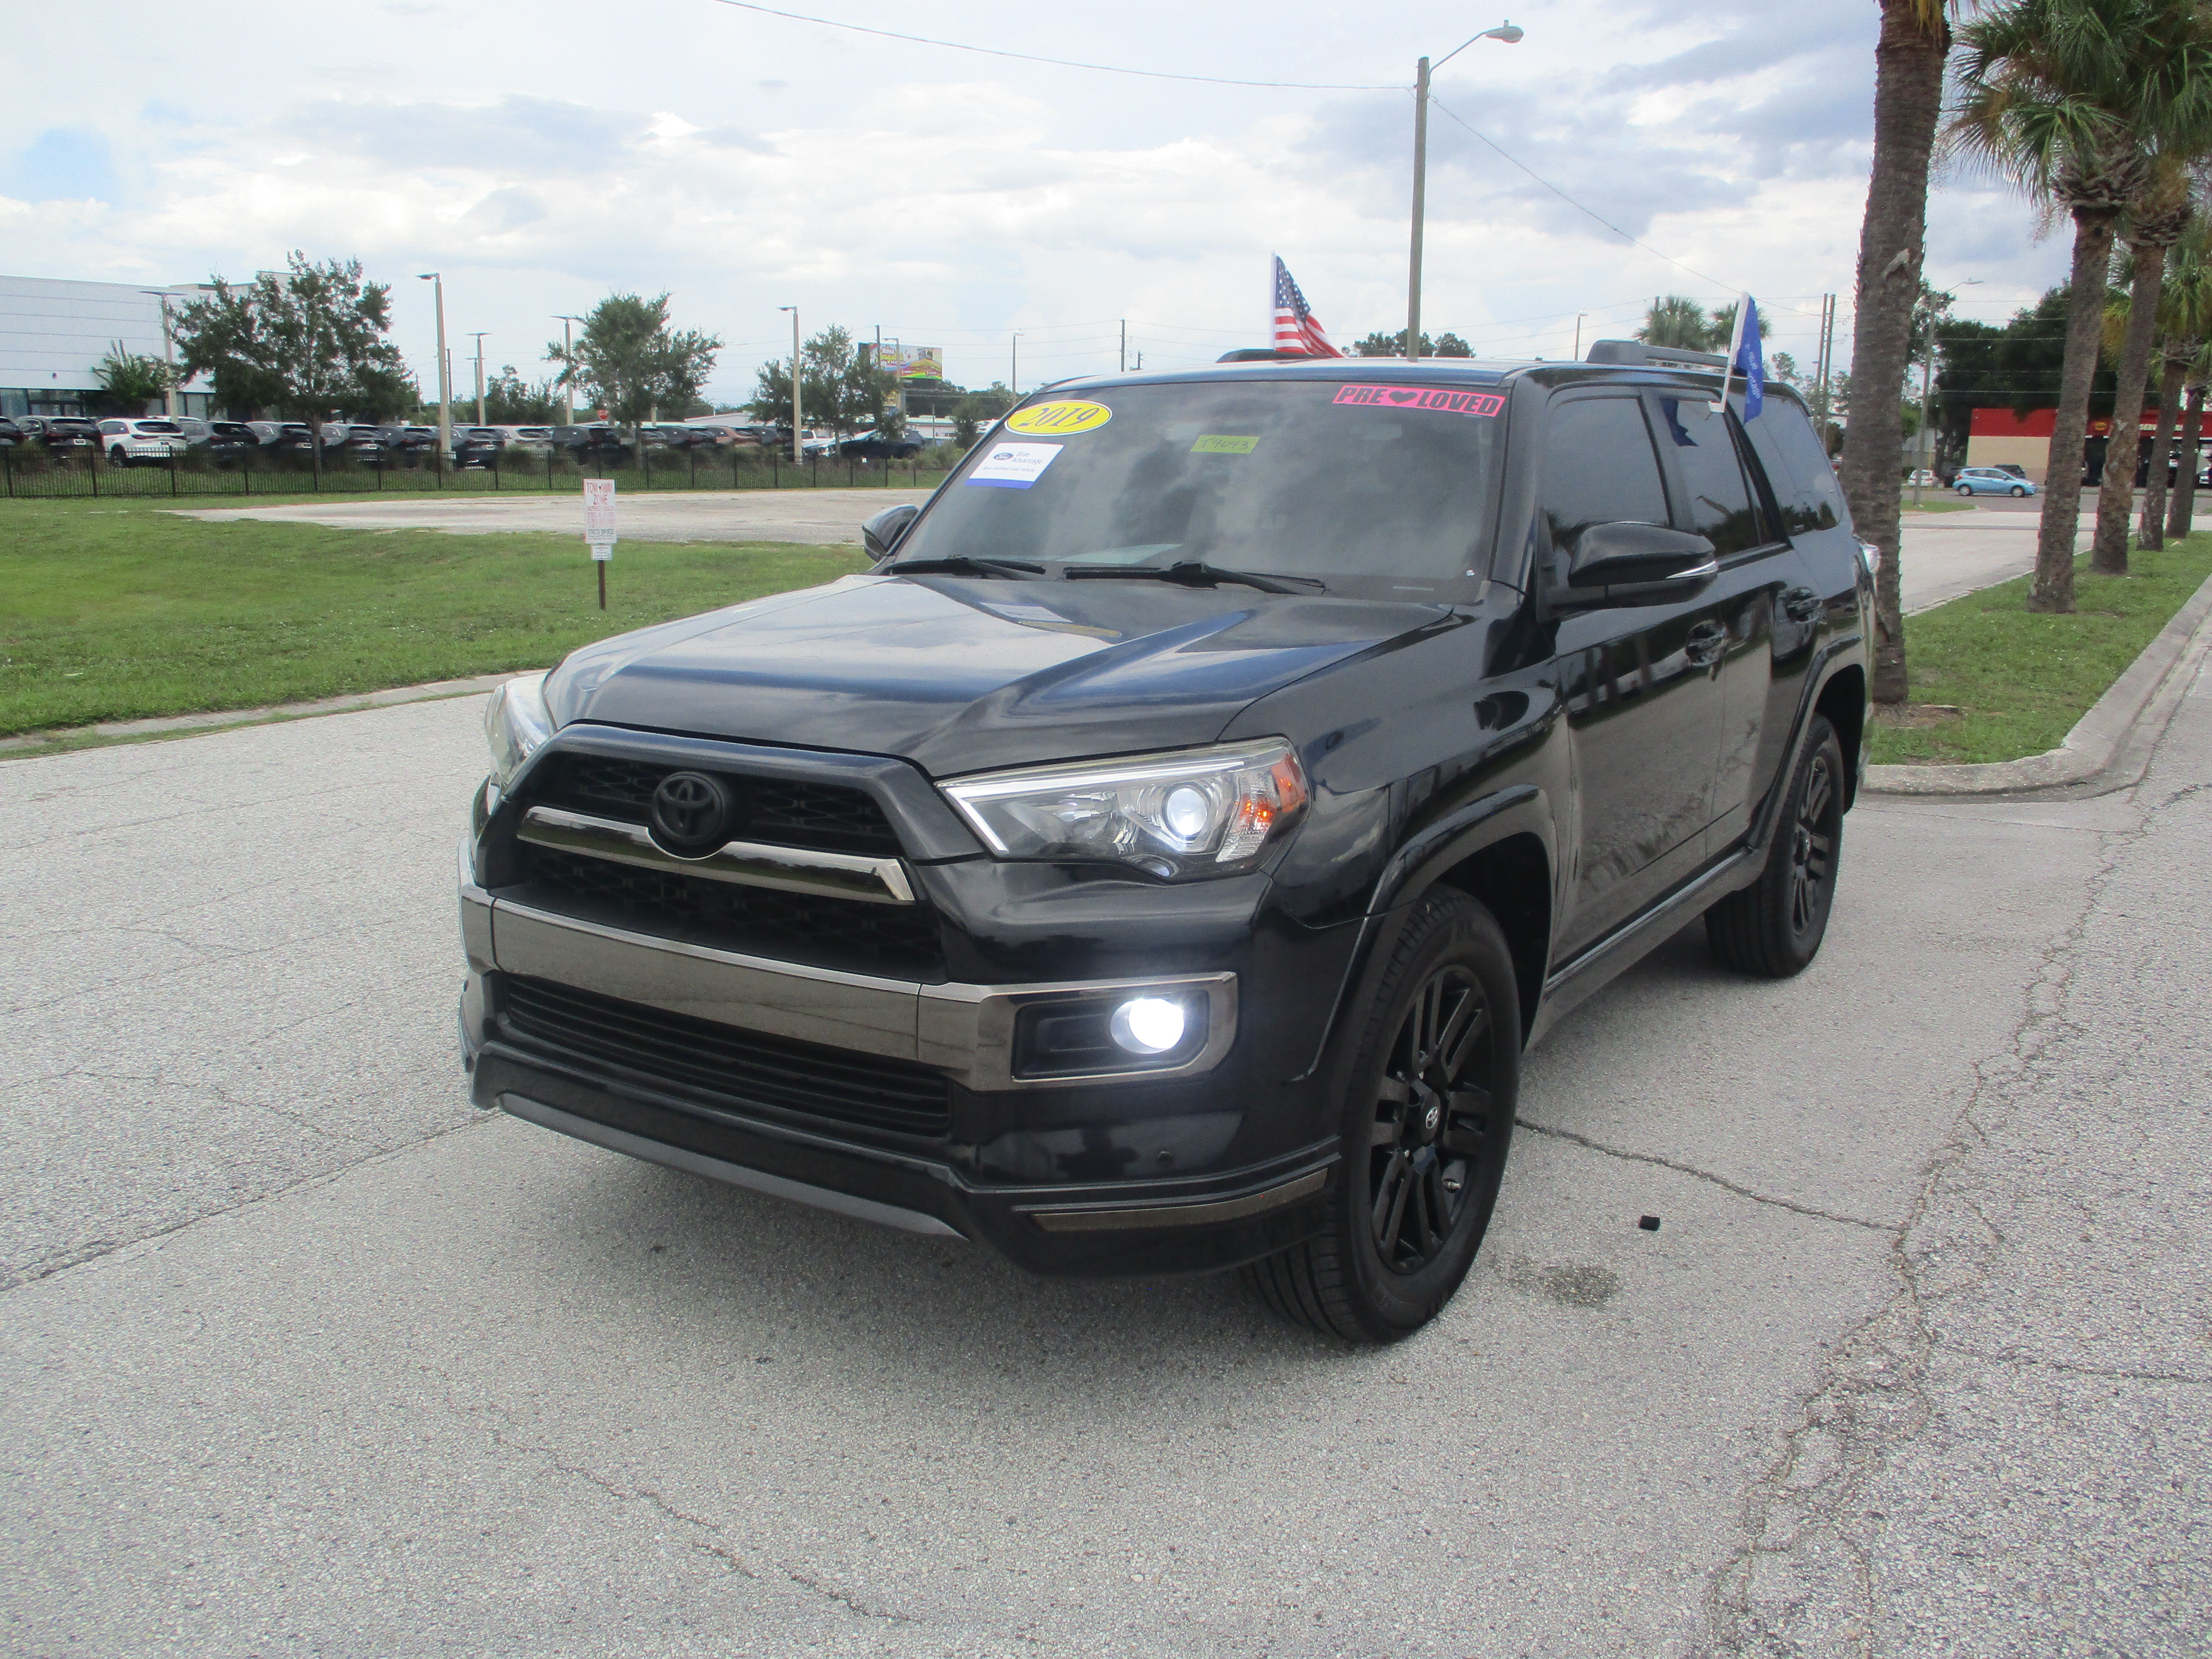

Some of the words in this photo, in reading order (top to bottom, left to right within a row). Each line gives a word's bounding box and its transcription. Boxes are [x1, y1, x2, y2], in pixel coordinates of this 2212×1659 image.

[1337, 387, 1388, 404] PRE
[1417, 391, 1500, 414] LOVED
[1016, 407, 1100, 427] 2019
